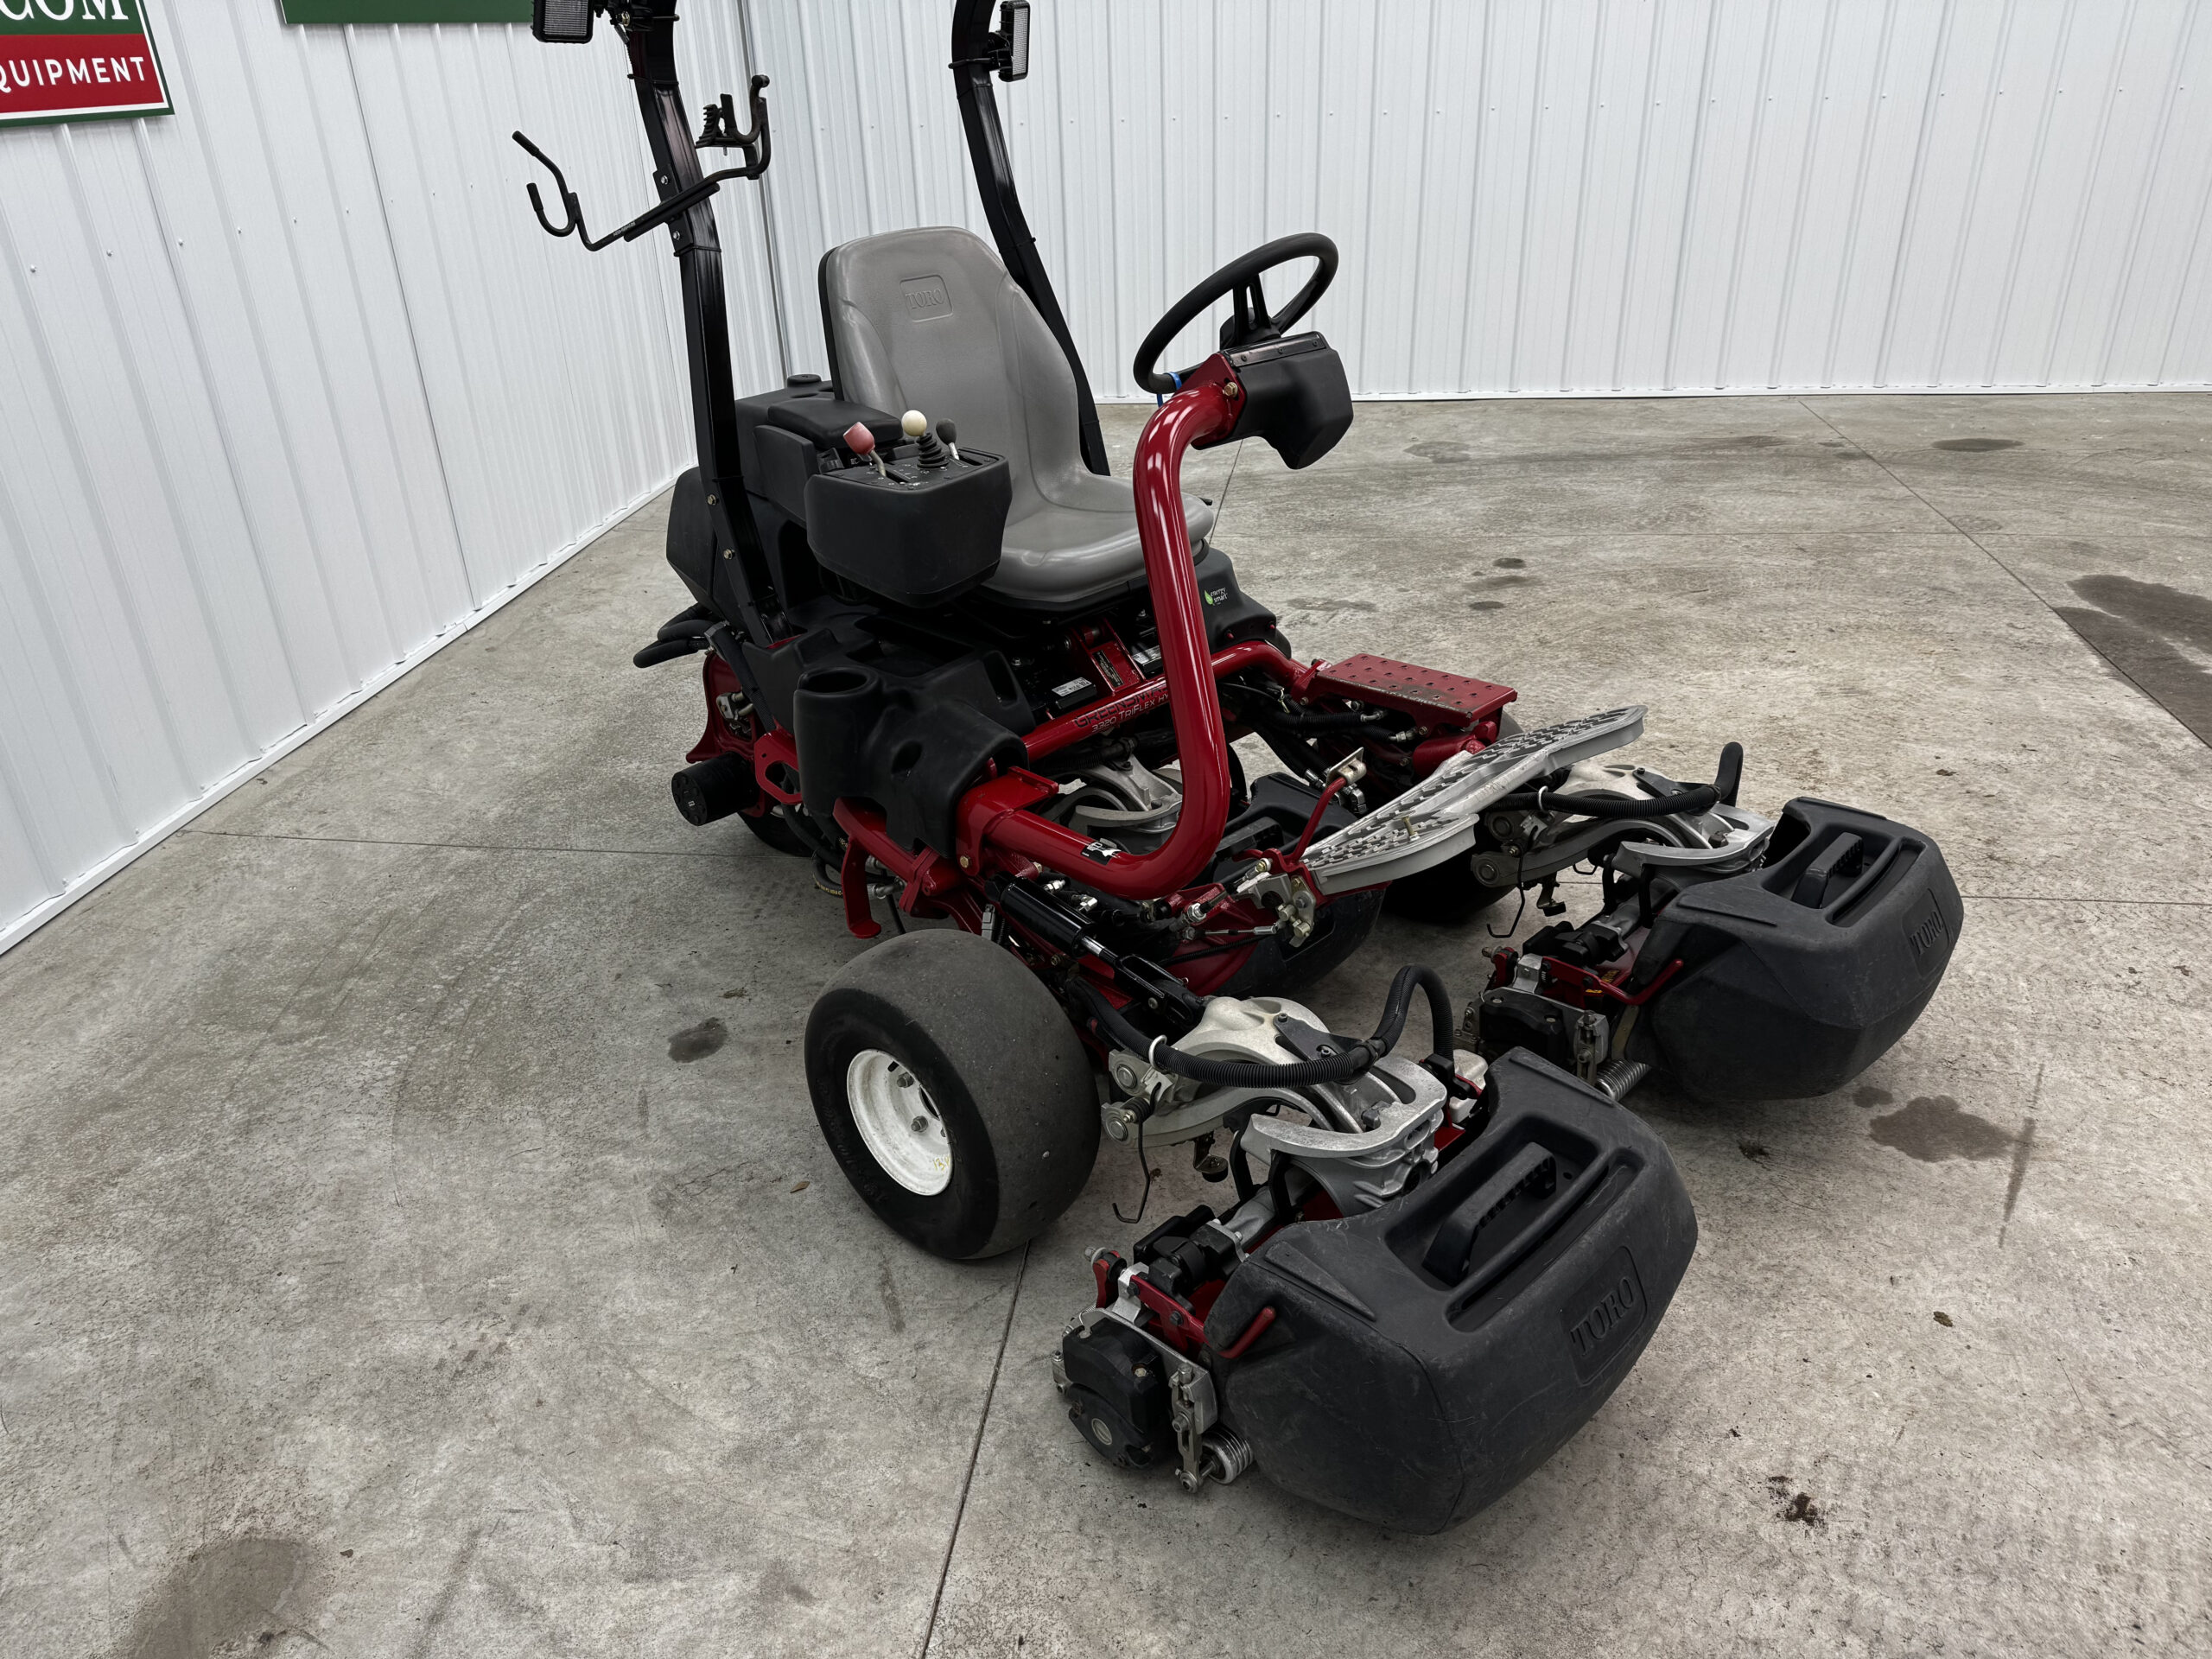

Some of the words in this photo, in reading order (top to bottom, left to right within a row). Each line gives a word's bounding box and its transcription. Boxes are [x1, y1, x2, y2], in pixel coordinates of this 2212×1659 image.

[905, 289, 944, 309] TORO
[1074, 687, 1168, 728] GREENSMA
[1092, 716, 1116, 733] 3320
[1909, 910, 1943, 956] TORO
[1569, 1276, 1634, 1358] TORO
